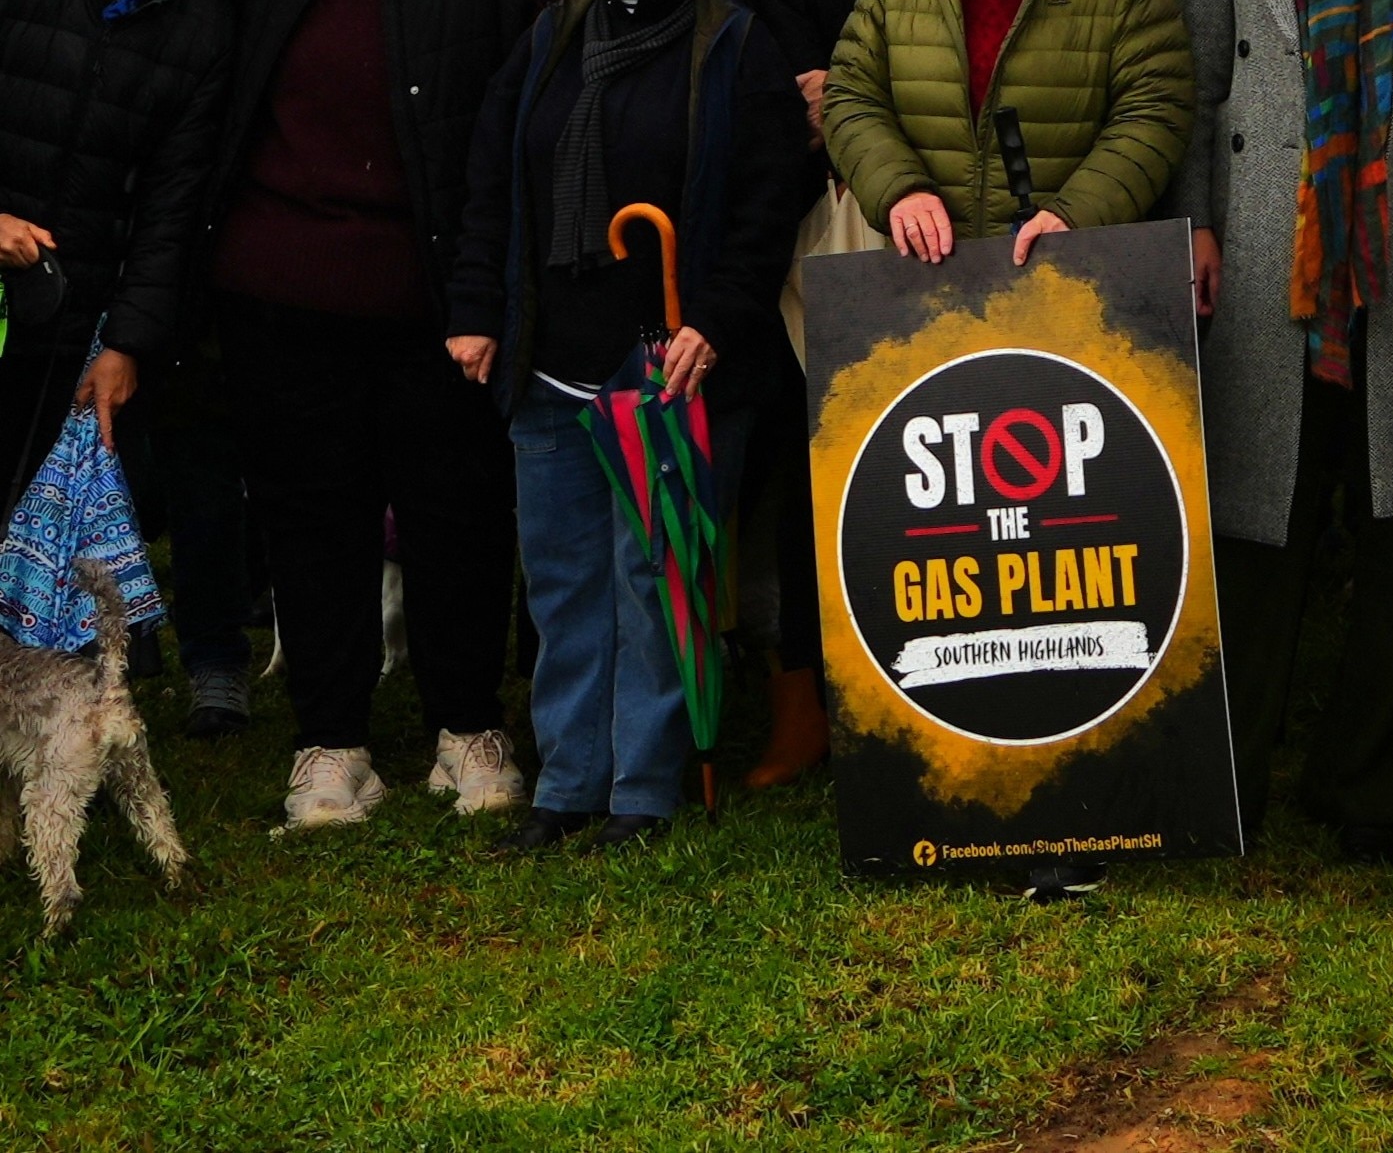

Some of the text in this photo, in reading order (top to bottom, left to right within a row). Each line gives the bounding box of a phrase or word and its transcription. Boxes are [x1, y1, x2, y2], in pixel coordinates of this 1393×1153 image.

[903, 403, 1104, 508] STOP
[986, 507, 1030, 540] THE
[894, 544, 1138, 622] GAS PLANT
[934, 635, 1104, 668] SOUTHERN HIGHLANDS
[942, 833, 1162, 860] Facebook.com/StopTheGasPlantSH
